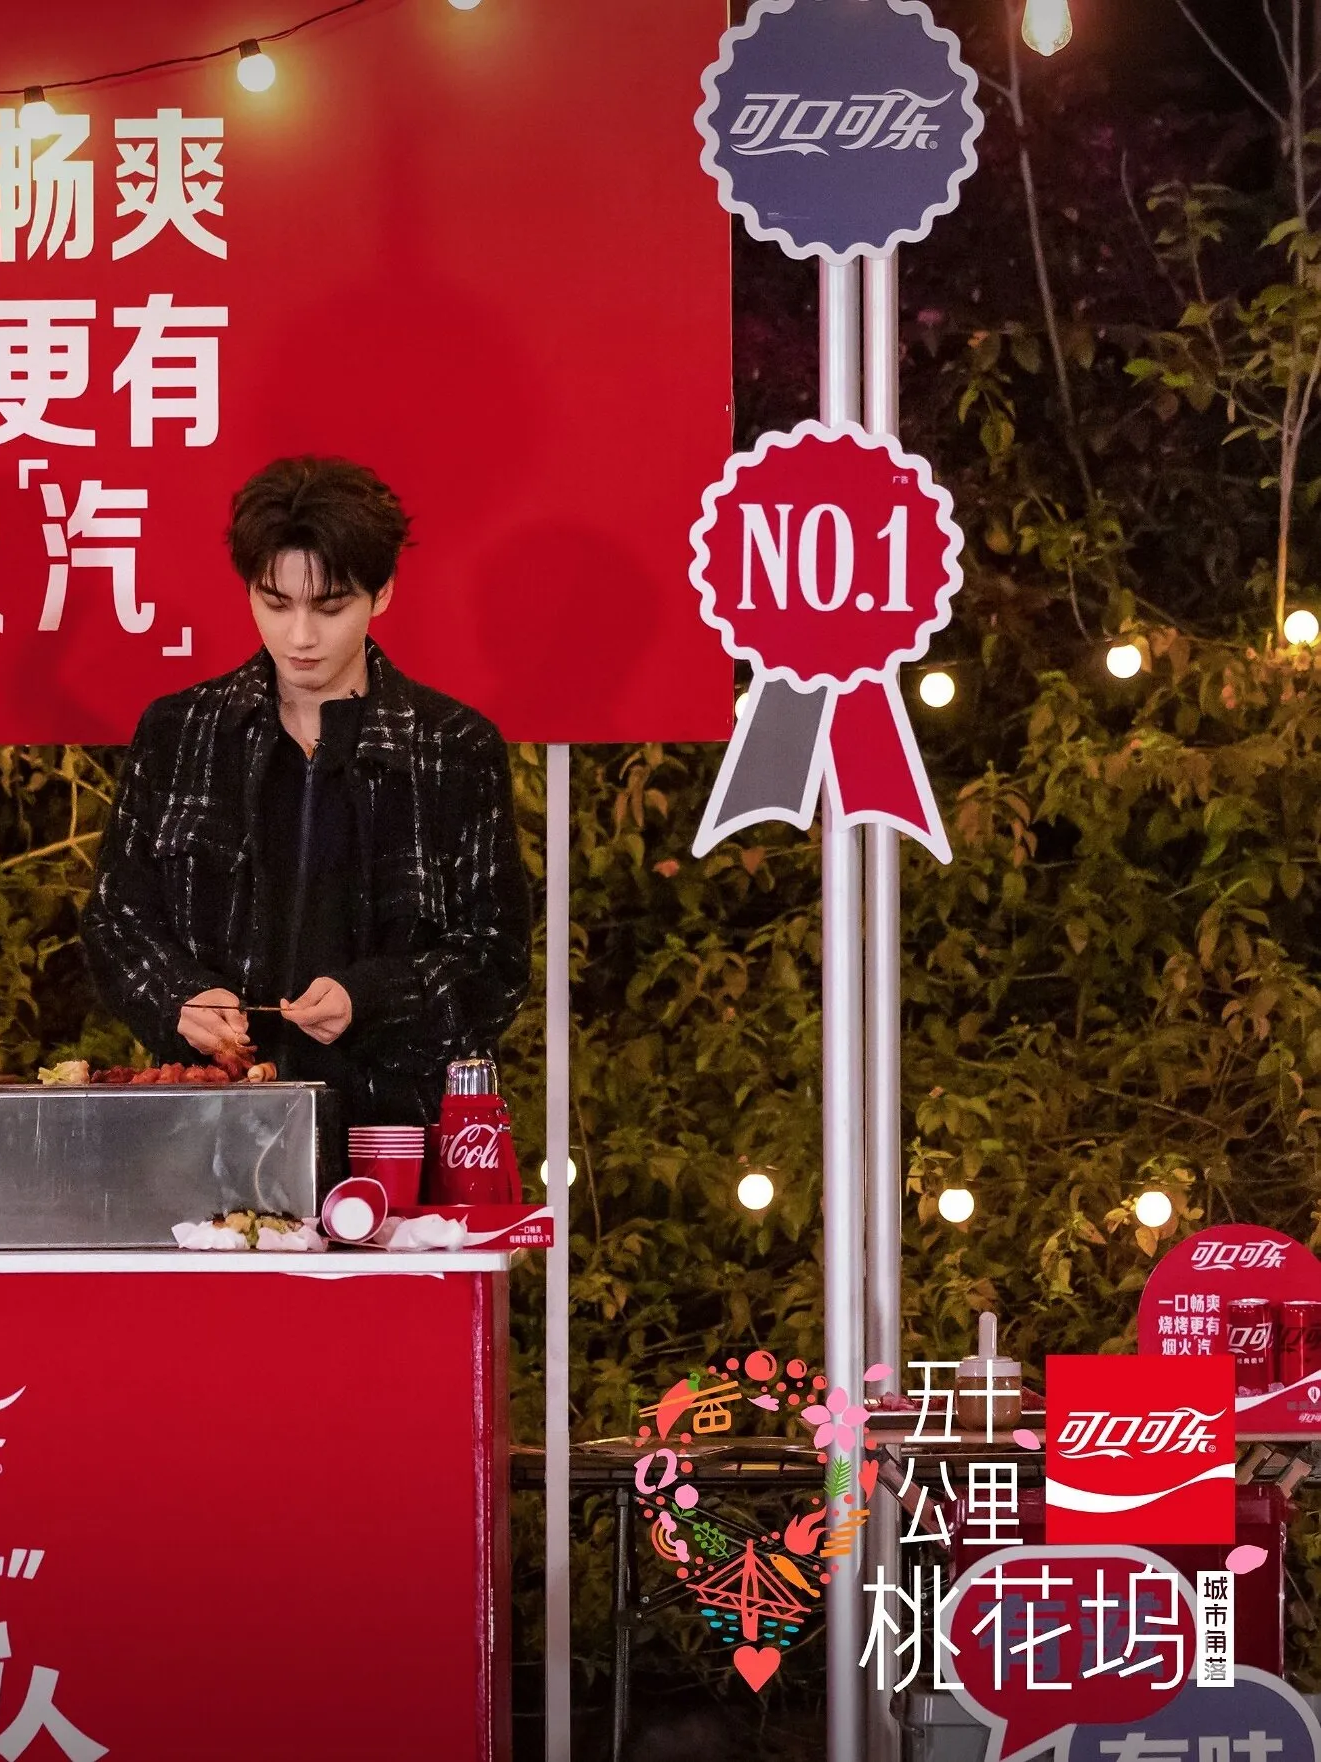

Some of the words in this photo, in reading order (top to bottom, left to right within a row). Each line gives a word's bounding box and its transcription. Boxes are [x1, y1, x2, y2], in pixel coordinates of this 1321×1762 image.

[730, 89, 954, 156] 可口可乐
[737, 503, 914, 612] NO.1
[1191, 1240, 1292, 1271] 可口可乐
[1158, 1294, 1221, 1314] 一口畅爽
[1158, 1316, 1221, 1336] 烧烤更有
